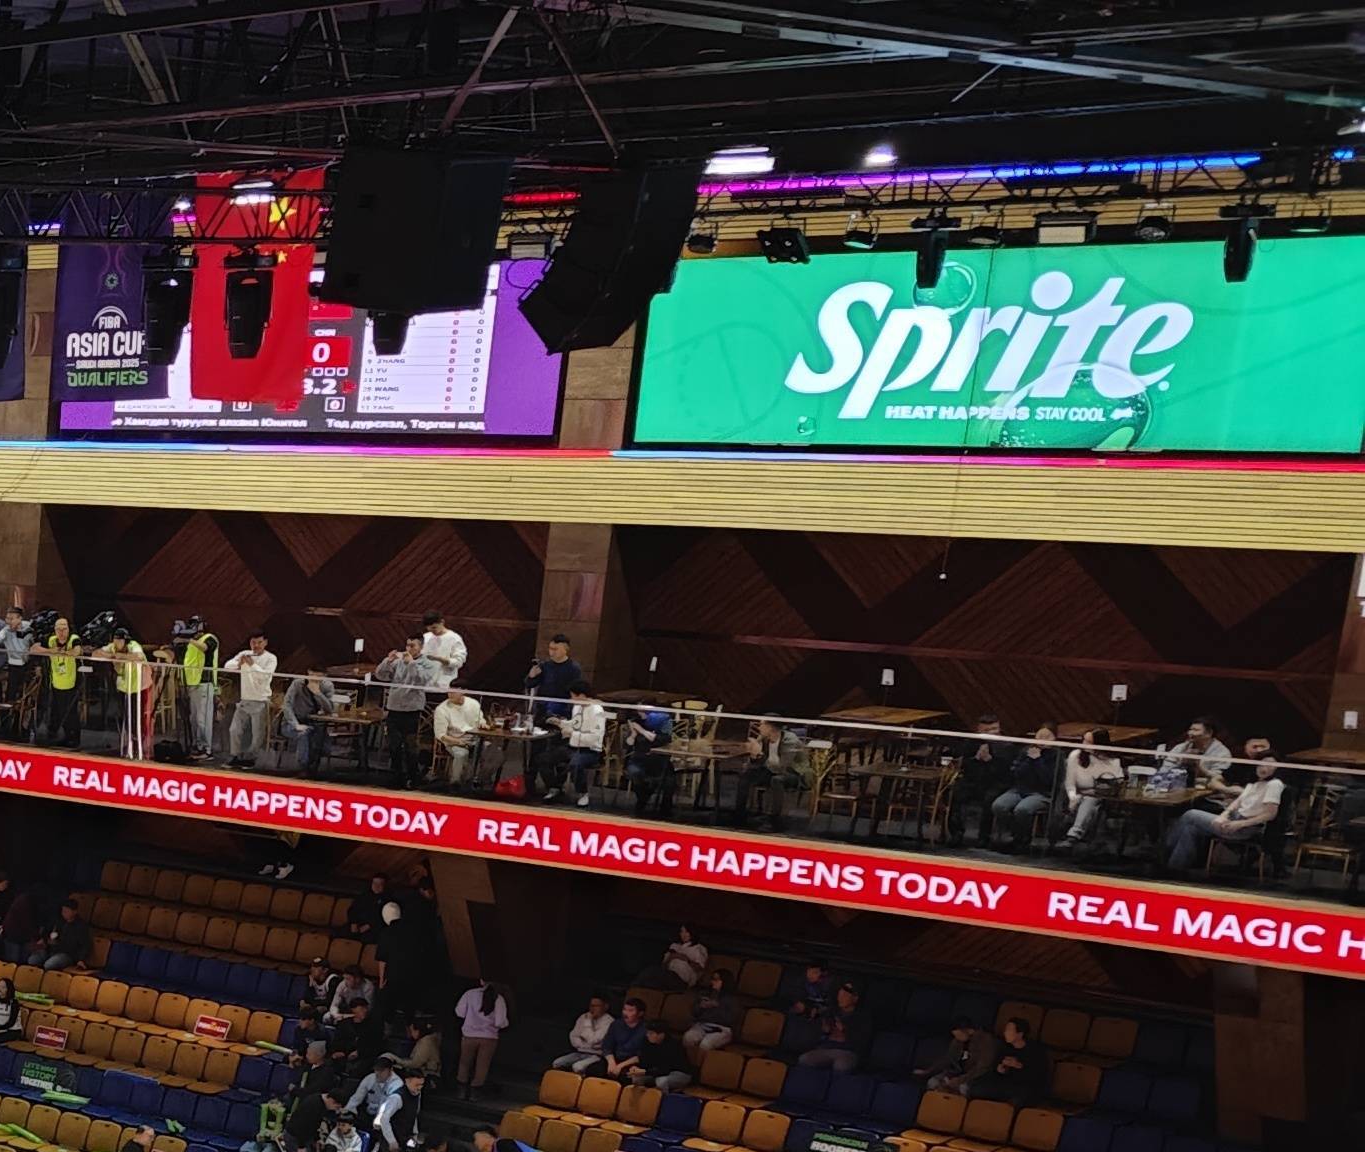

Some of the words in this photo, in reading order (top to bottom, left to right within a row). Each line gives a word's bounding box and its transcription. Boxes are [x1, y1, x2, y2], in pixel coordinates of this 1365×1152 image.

[98, 315, 120, 329] FIBA
[66, 332, 111, 358] ASIA
[311, 342, 331, 363] 0
[783, 270, 1194, 420] Sprite
[66, 370, 148, 388] QUALIFIERS
[885, 405, 937, 420] HEAT
[938, 405, 1031, 421] HAPPENS
[1034, 405, 1069, 421] STAY
[1069, 406, 1107, 422] COOL
[54, 766, 116, 793] REAL
[124, 775, 206, 805] MAGIC
[214, 786, 343, 823] HAPPENS
[351, 803, 448, 836] TODAY
[479, 819, 560, 852] REAL
[571, 831, 681, 867] MAGIC
[691, 847, 864, 892] HAPPENS
[876, 870, 1009, 911] TODAY
[1048, 892, 1159, 932] REAL
[1174, 909, 1326, 953] MAGIC
